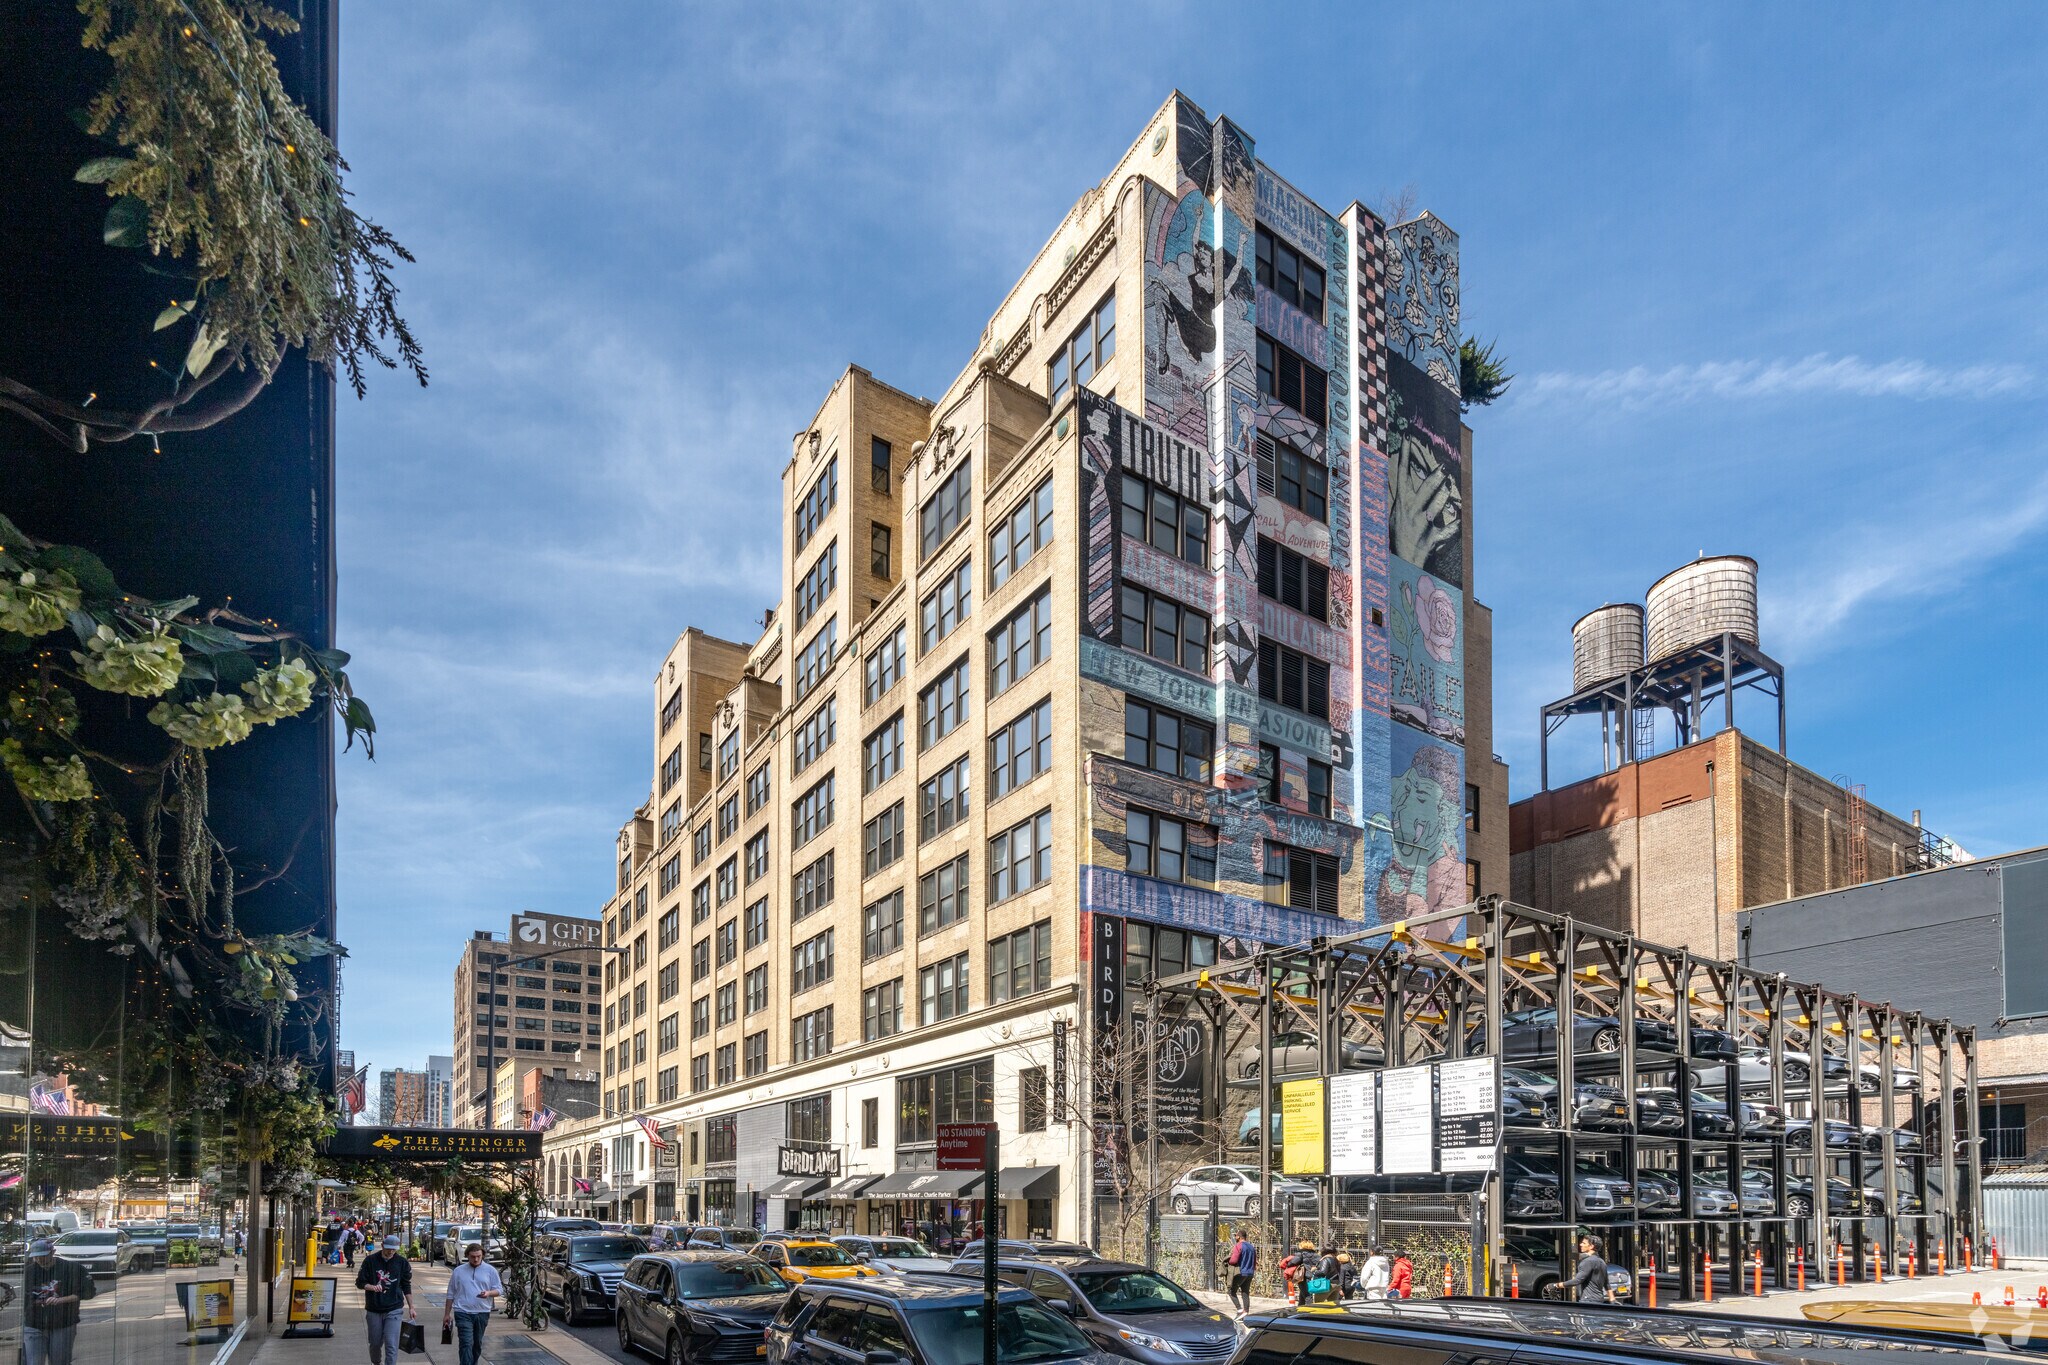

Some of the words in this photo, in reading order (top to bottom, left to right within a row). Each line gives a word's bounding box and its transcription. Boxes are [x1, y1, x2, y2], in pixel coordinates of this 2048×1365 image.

[1328, 225, 1347, 311] LANDS
[1329, 313, 1349, 396] OTHER
[1081, 388, 1095, 402] MY
[1098, 397, 1117, 416] SIN
[1329, 401, 1349, 434] TO
[1125, 415, 1201, 503] TRUTH
[1331, 438, 1351, 568] JOURNEY
[1364, 457, 1387, 526] ALMA
[1257, 514, 1279, 527] CALL
[1287, 534, 1329, 551] ADVENTURE
[1365, 532, 1387, 576] DEL
[1121, 543, 1247, 618] AMERICAN
[1257, 600, 1350, 668] EDUCATION
[1090, 647, 1142, 685] NEW
[1157, 673, 1212, 710] YORK
[1366, 681, 1388, 708] EL
[1390, 653, 1463, 720] FAILE
[1289, 815, 1323, 847] 1986
[1086, 868, 1159, 918] BUILD
[1167, 884, 1225, 929] YOUR
[1233, 899, 1280, 941] OWN
[553, 922, 601, 943] GFP
[1103, 923, 1115, 1095] BIRDLAND
[404, 1136, 440, 1145] THE
[448, 1137, 527, 1147] STINGER
[940, 1129, 950, 1137] NO
[951, 1128, 986, 1137] STANDING
[940, 1139, 969, 1150] Anytime
